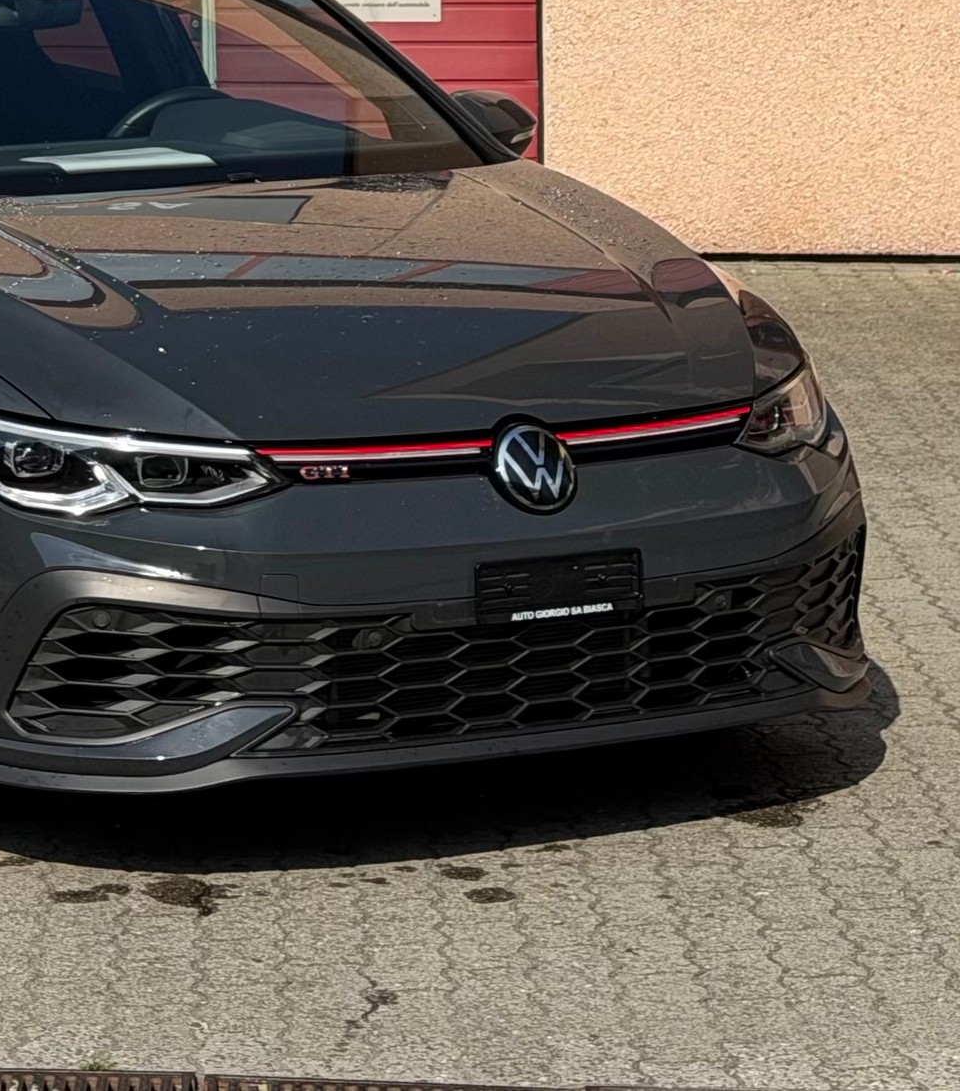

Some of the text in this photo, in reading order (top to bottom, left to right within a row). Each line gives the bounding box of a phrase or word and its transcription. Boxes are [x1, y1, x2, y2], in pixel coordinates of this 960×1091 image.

[300, 465, 350, 480] GTI
[511, 603, 613, 621] AUTO GIORGIO SA BIASCA
